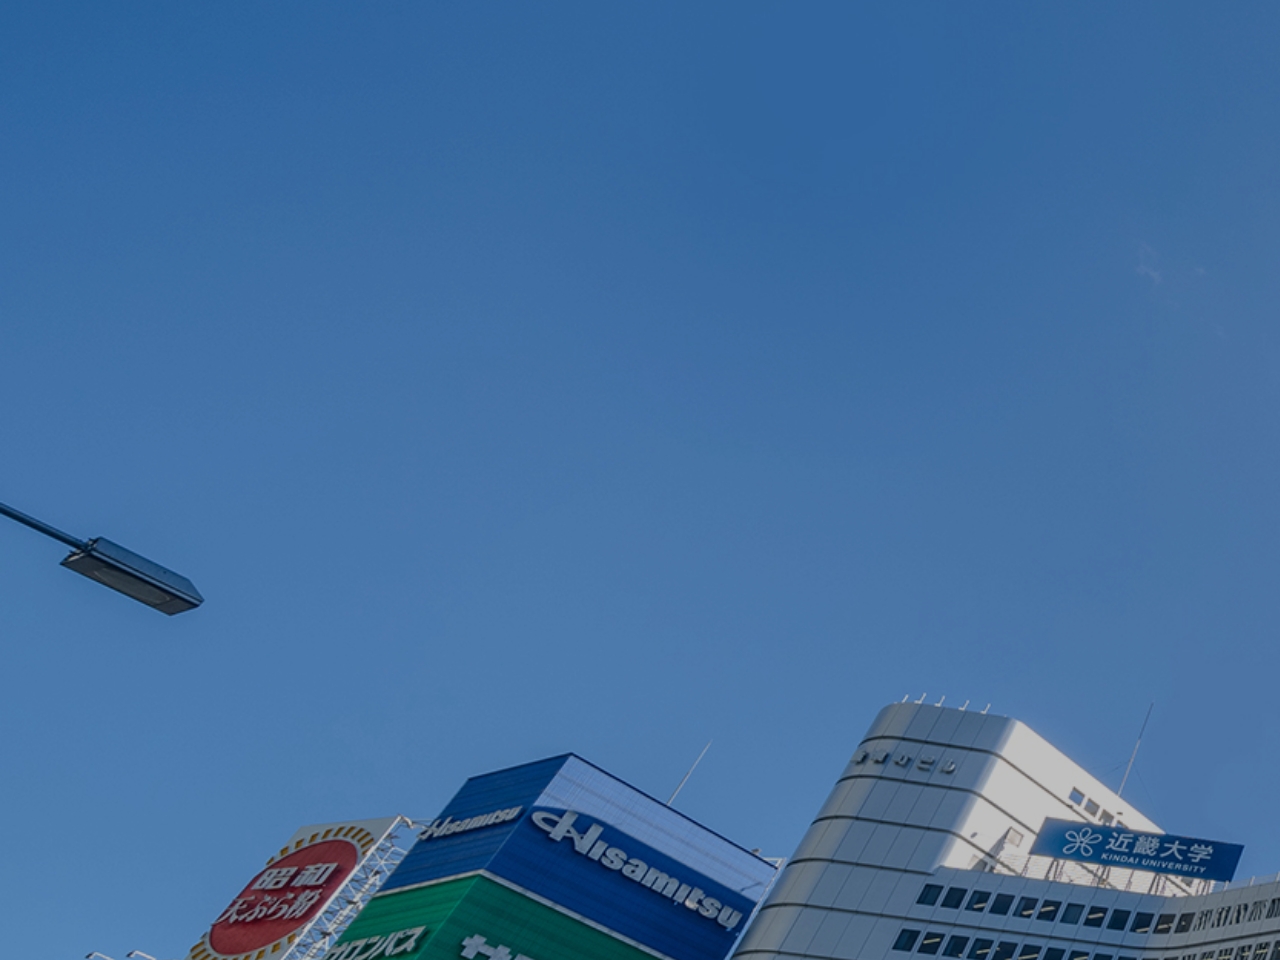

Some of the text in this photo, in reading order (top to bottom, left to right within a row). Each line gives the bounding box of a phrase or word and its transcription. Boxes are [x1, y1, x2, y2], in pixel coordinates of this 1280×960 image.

[418, 806, 523, 840] Hisamitsu
[1101, 852, 1207, 874] KINDAI UNIVERSITY
[1105, 831, 1214, 863] 近畿大学
[251, 863, 339, 890] 昭和
[531, 810, 743, 930] Hisamitsu
[213, 889, 323, 924] 天ぷら粉
